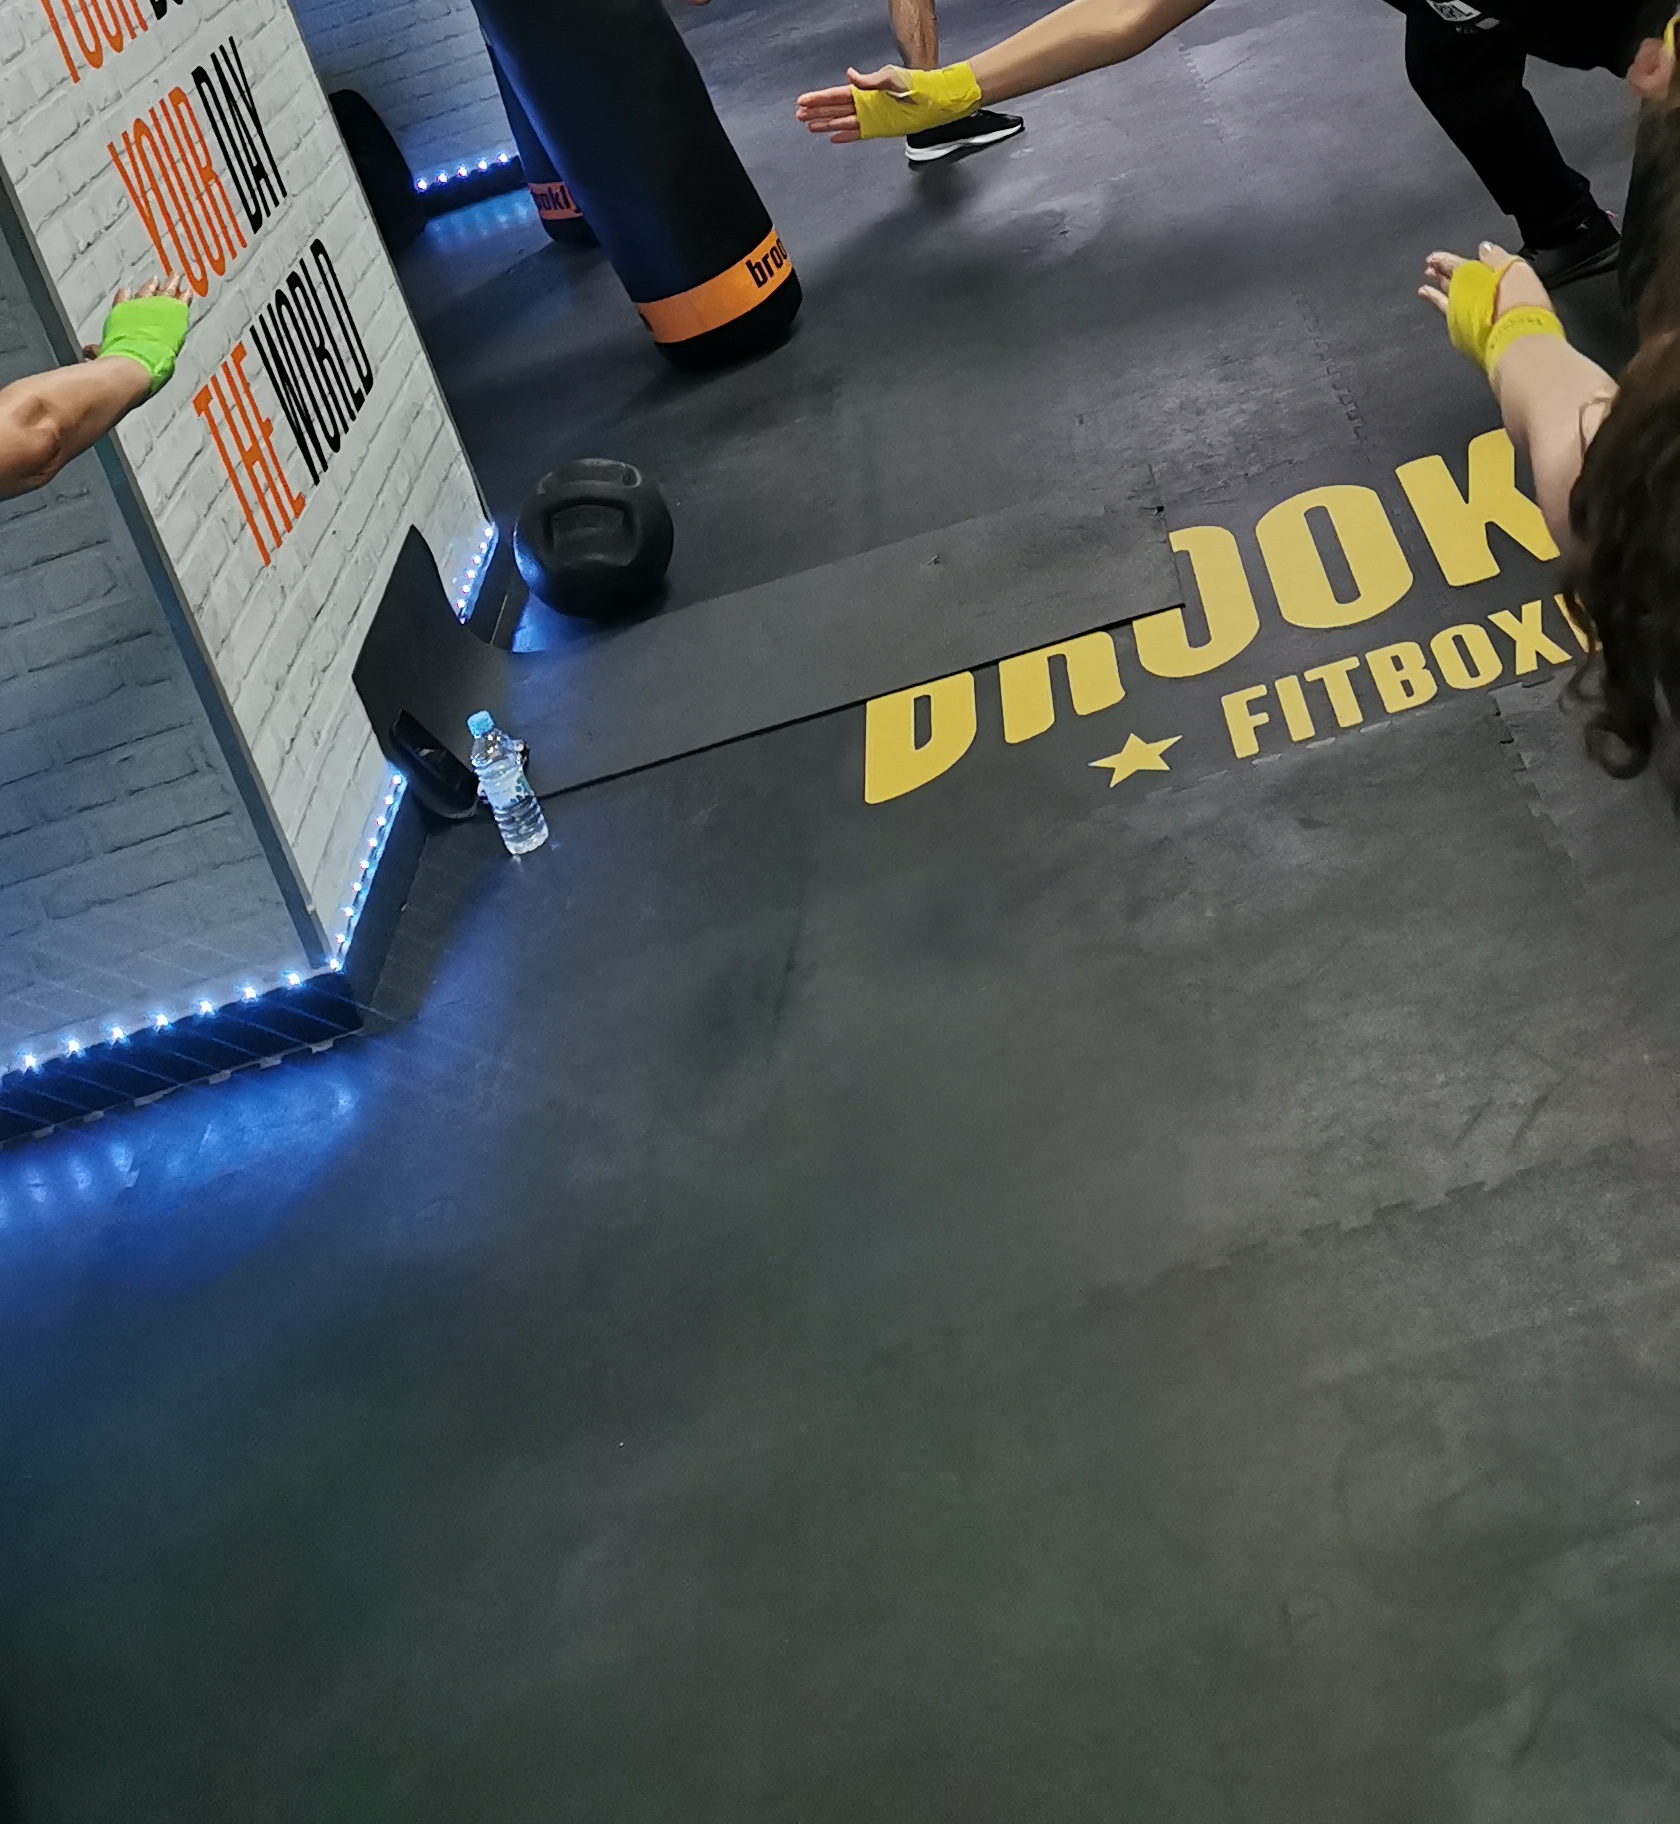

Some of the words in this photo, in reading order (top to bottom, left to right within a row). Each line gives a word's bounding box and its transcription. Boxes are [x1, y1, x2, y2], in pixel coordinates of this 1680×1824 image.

[106, 86, 248, 298] YOUR
[190, 35, 288, 235] DAY
[192, 341, 306, 567] THE
[248, 237, 375, 486] WORLD
